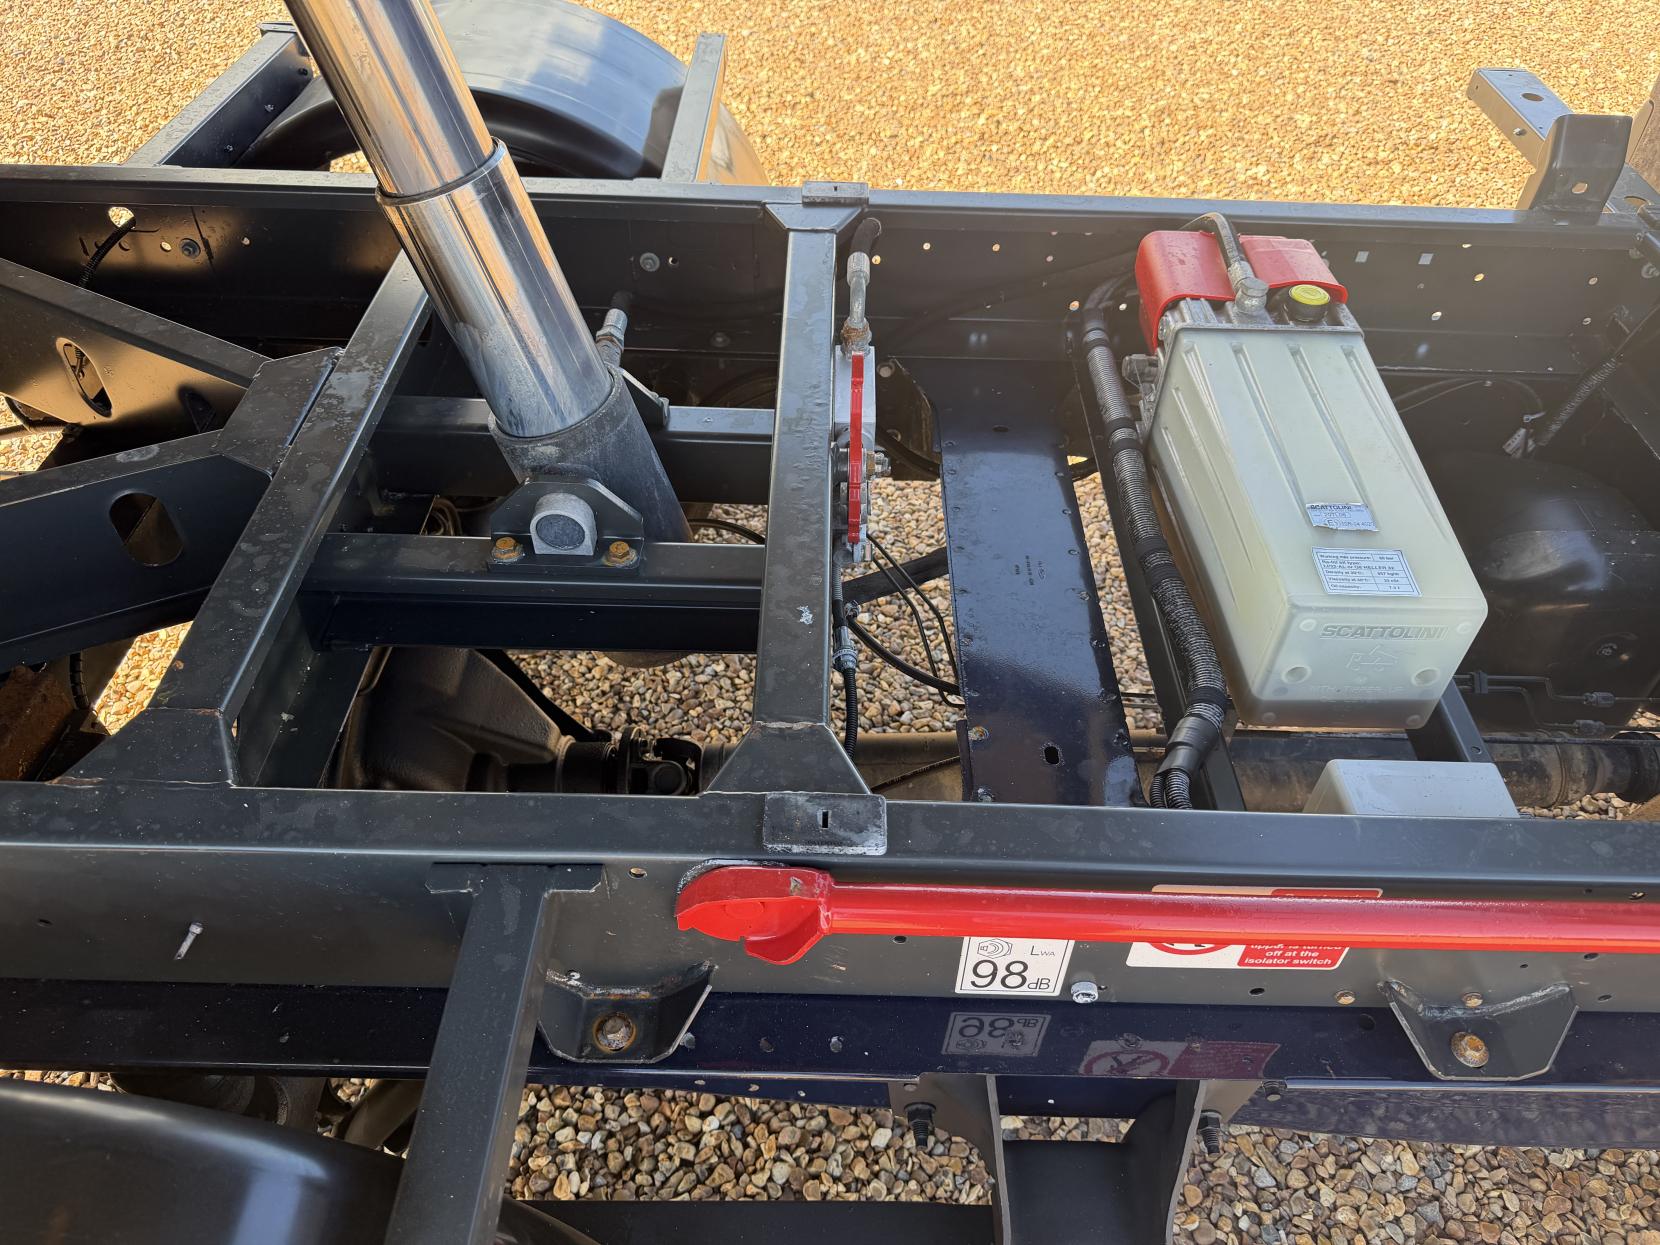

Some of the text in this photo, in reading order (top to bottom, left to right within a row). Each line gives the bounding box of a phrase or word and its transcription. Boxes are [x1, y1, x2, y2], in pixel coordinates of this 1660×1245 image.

[1320, 624, 1445, 638] SCATTOLINI
[1244, 957, 1332, 965] isolator switch
